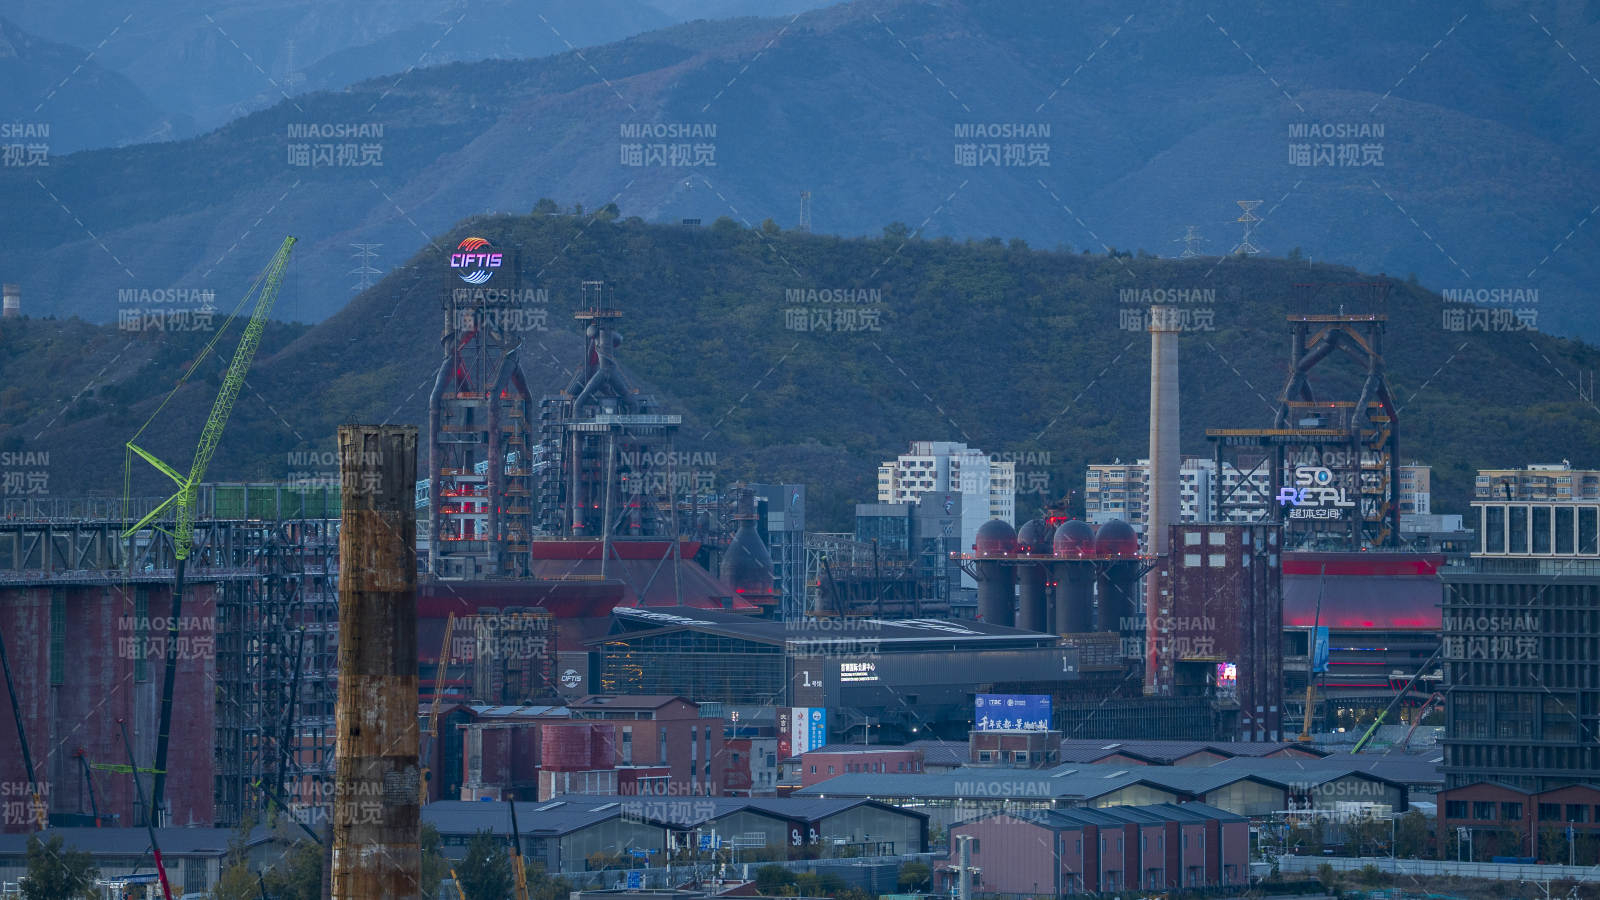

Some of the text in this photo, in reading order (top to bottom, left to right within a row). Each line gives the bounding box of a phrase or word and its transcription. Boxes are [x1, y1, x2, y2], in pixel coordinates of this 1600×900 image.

[450, 253, 503, 268] CIFTIS
[1295, 467, 1333, 486] SO
[1275, 487, 1356, 507] REAL
[1289, 508, 1339, 519] 超体空间
